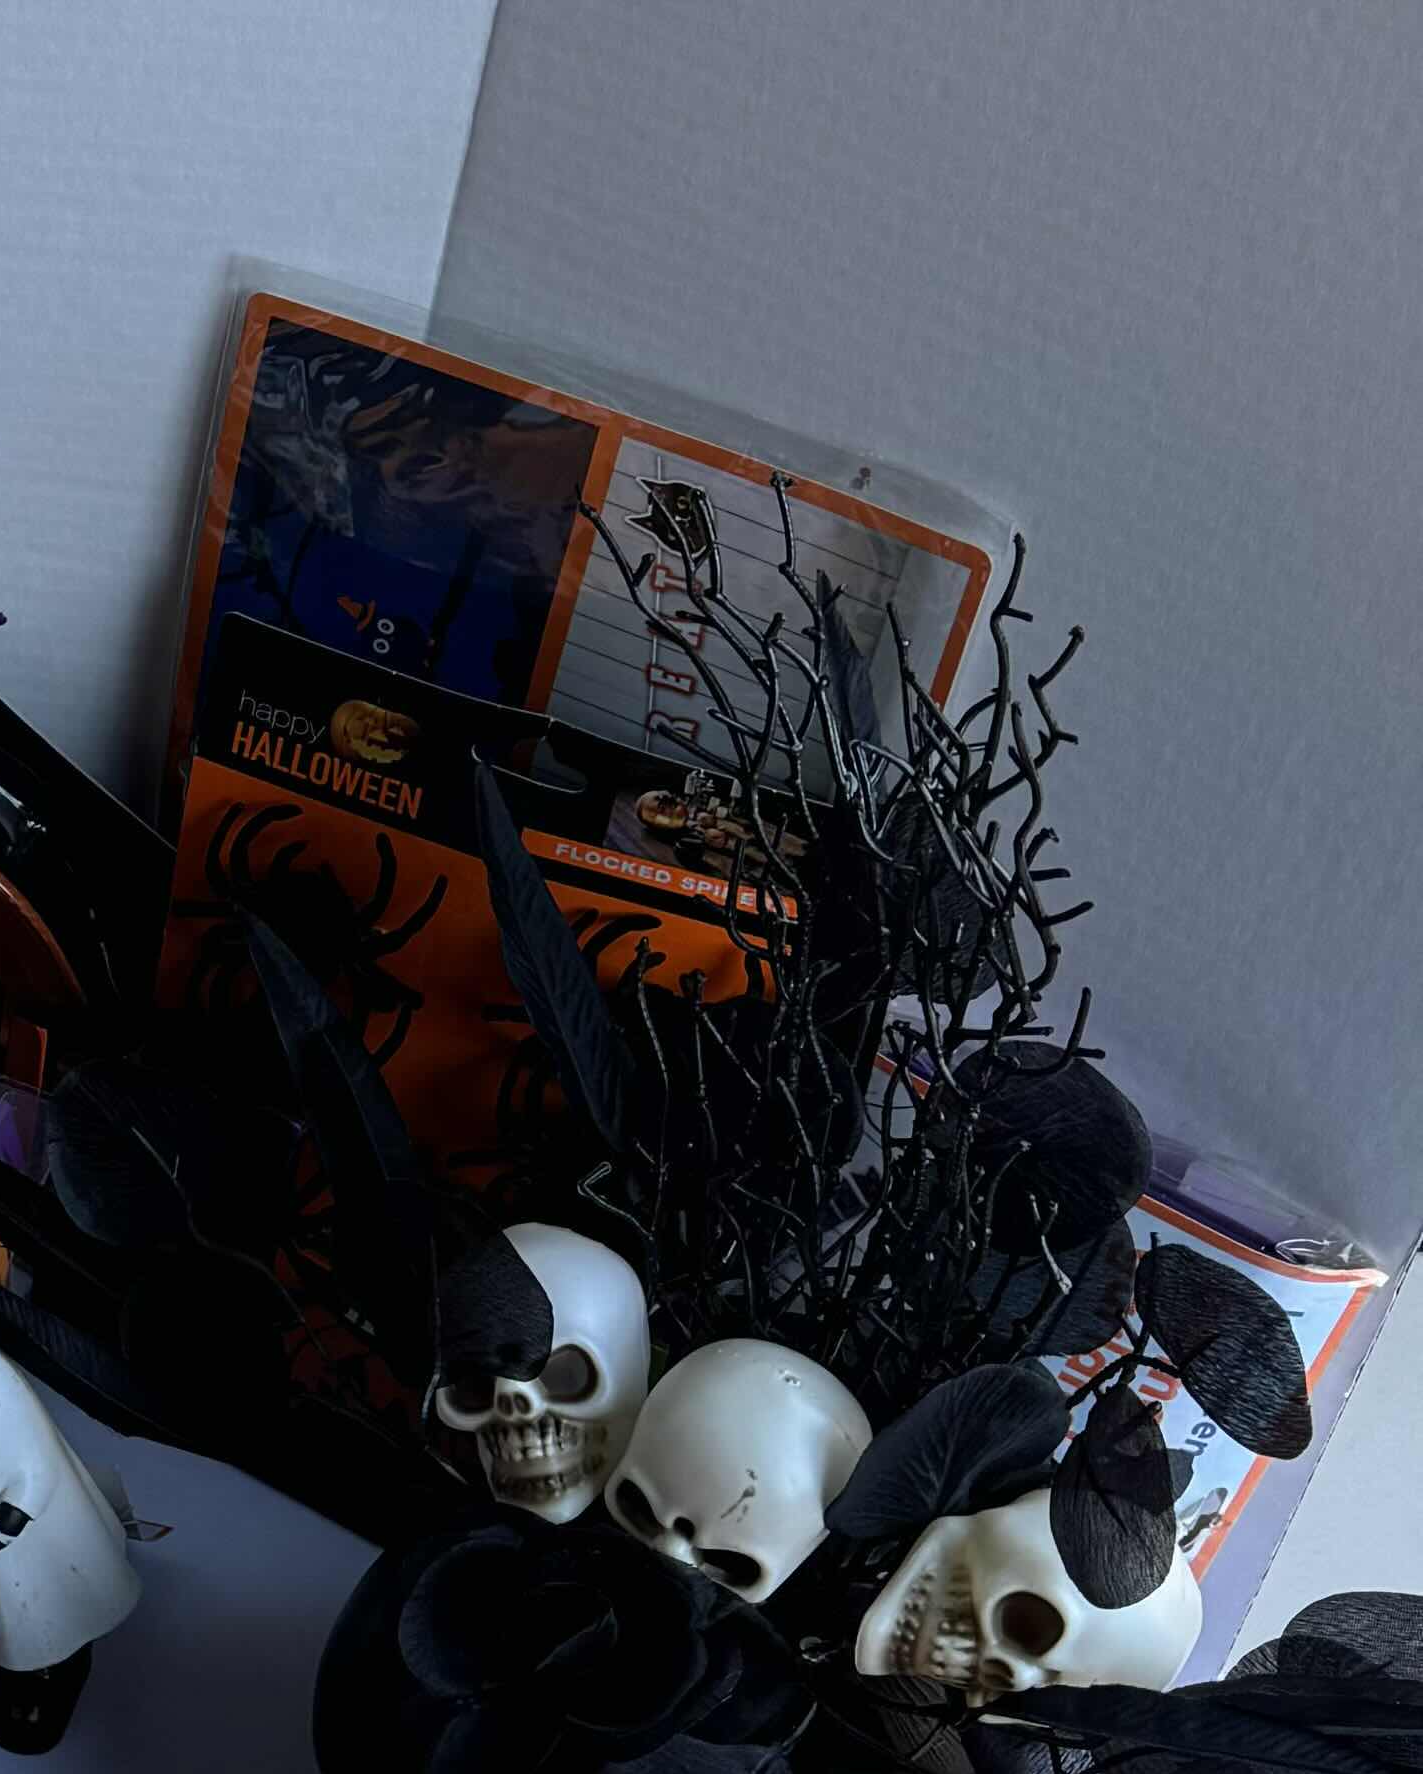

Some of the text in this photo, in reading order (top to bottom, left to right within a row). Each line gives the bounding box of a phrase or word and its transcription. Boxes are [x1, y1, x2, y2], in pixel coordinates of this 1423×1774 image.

[237, 689, 328, 744] happy
[231, 720, 424, 821] HALLOWEEN
[555, 843, 777, 913] FLOCKED SPIE
